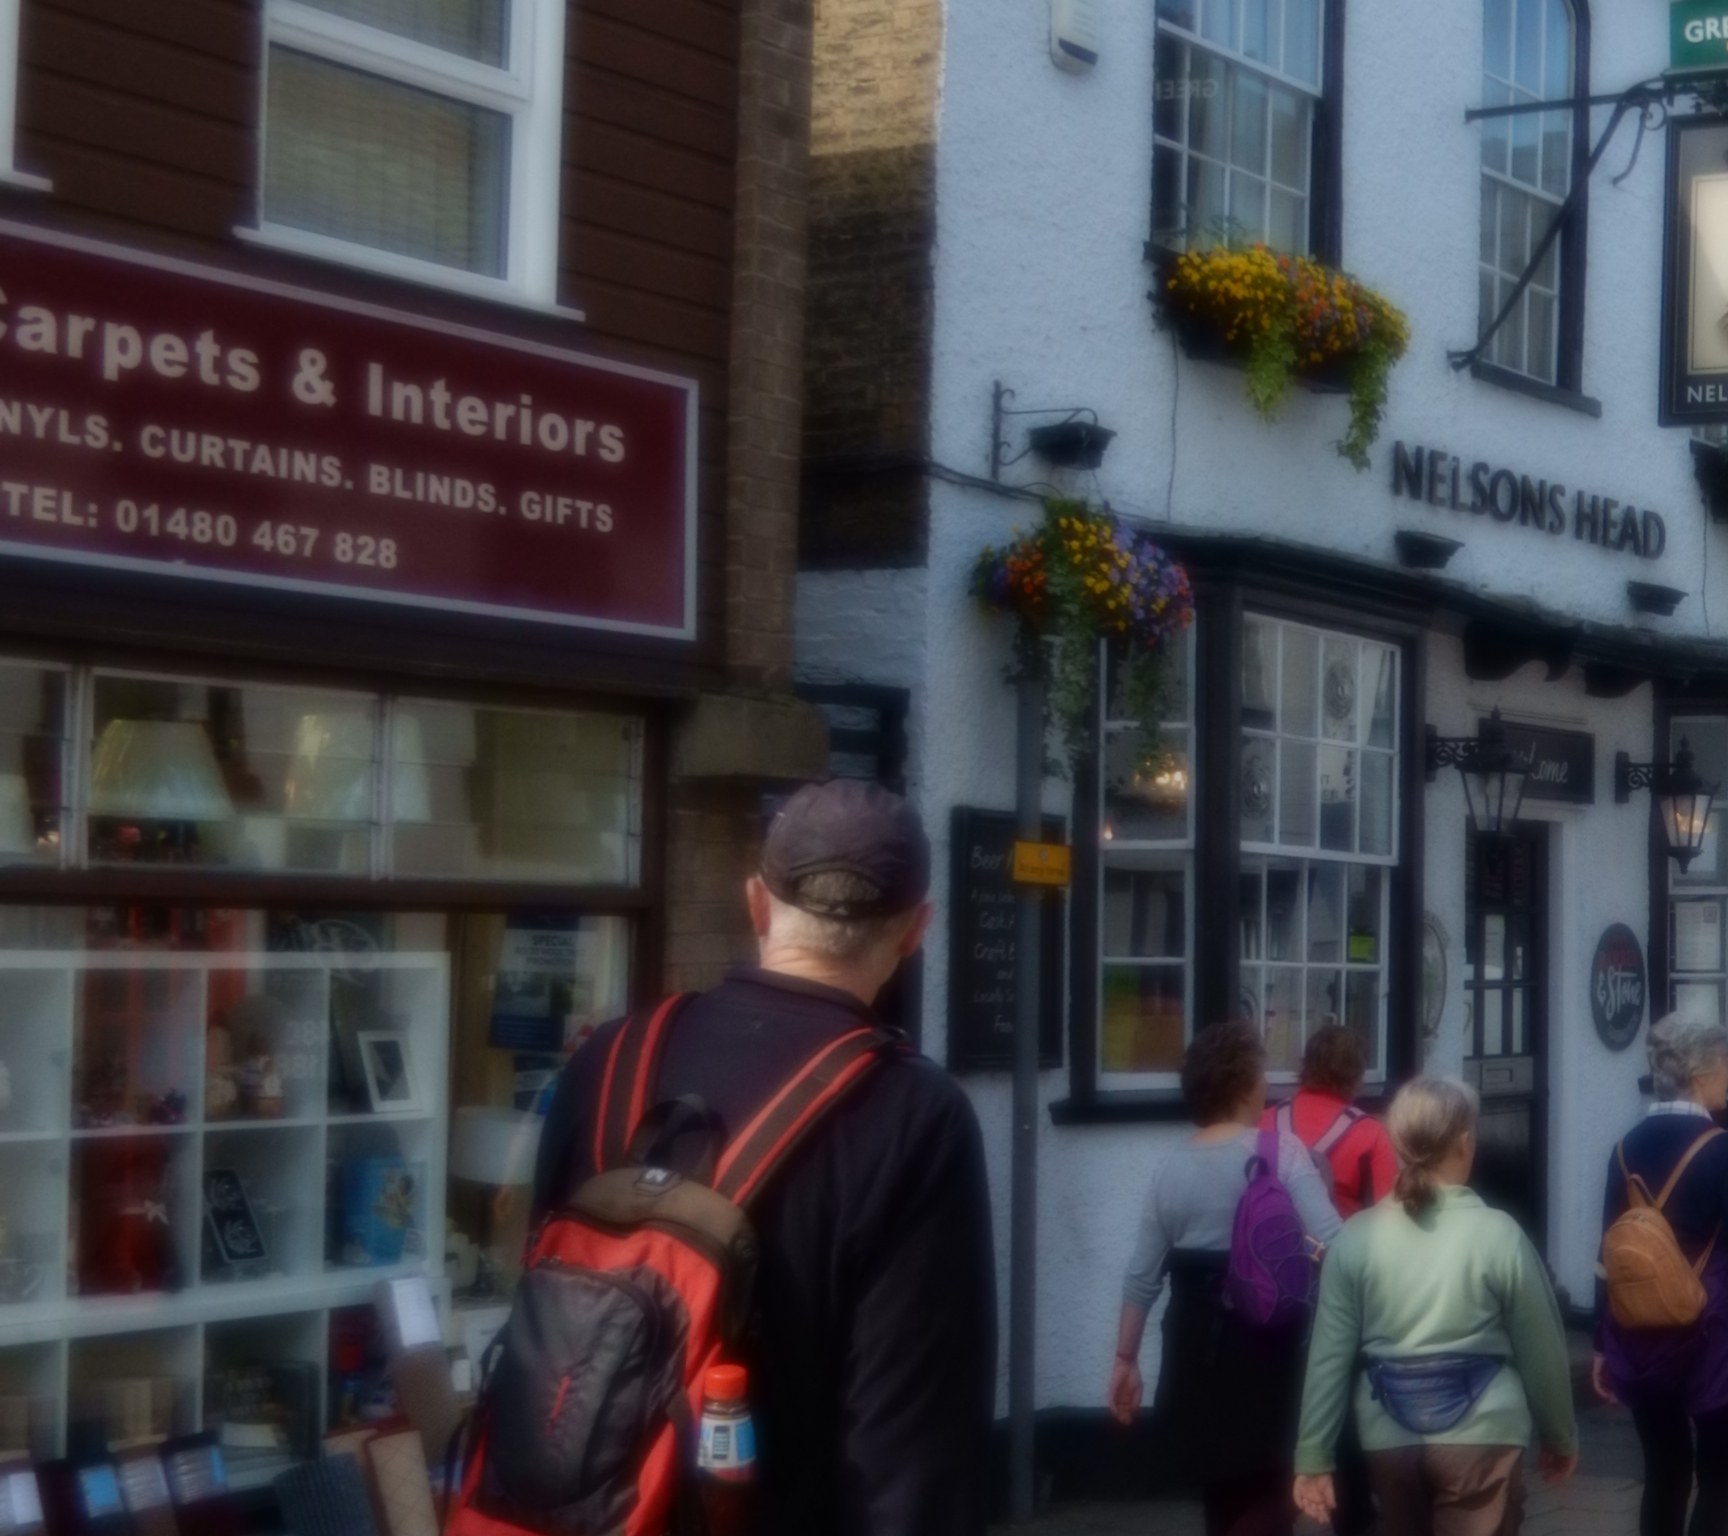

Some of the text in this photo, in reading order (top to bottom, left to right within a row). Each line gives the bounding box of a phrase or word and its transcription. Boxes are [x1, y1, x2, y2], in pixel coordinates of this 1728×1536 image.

[292, 348, 337, 407] &
[367, 362, 626, 462] Interiors
[1, 480, 398, 569] TEL: 01480 467 828
[140, 424, 354, 490] CURTAINS.
[369, 463, 506, 515] BLINDS.
[520, 489, 615, 533] GIFTS
[1392, 439, 1666, 560] NELSONS HEAD
